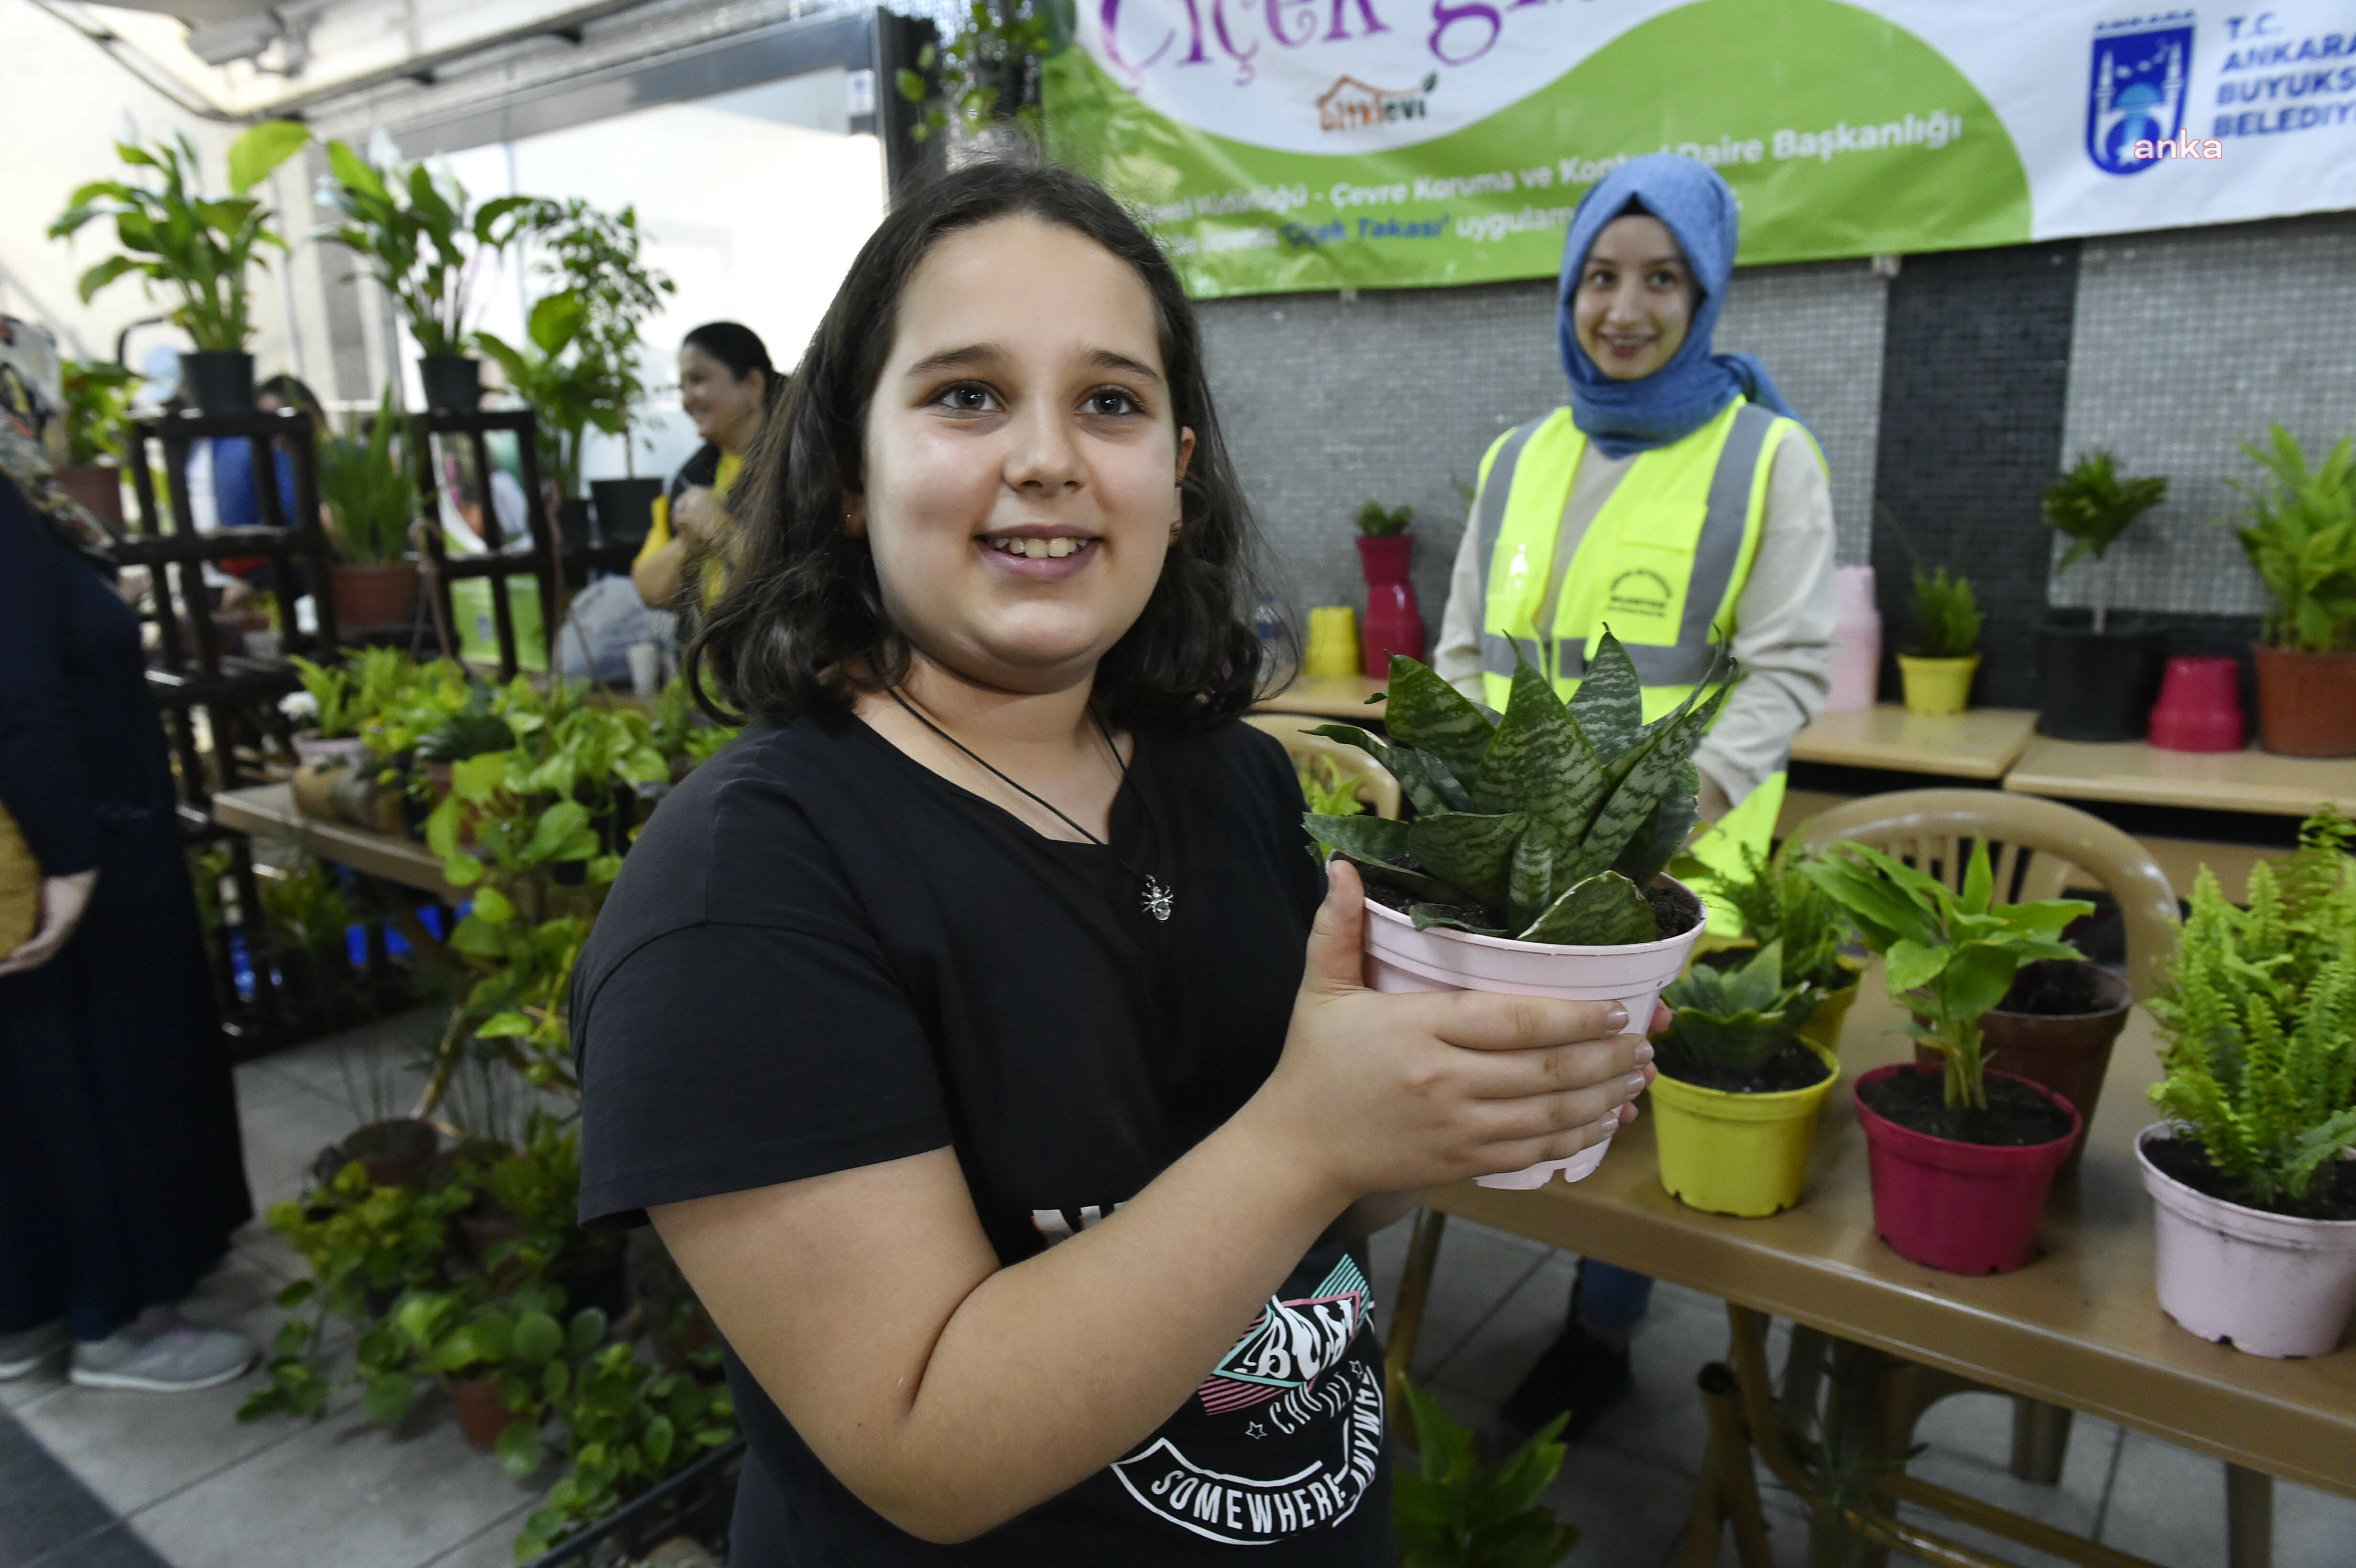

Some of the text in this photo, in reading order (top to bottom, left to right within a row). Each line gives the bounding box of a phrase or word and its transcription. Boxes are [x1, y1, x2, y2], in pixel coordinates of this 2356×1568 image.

[1330, 182, 1408, 211] Çevre
[1413, 171, 1516, 201] Koruma
[1520, 166, 1554, 188] ve
[1151, 1469, 1347, 1534] SOMEWHERE
